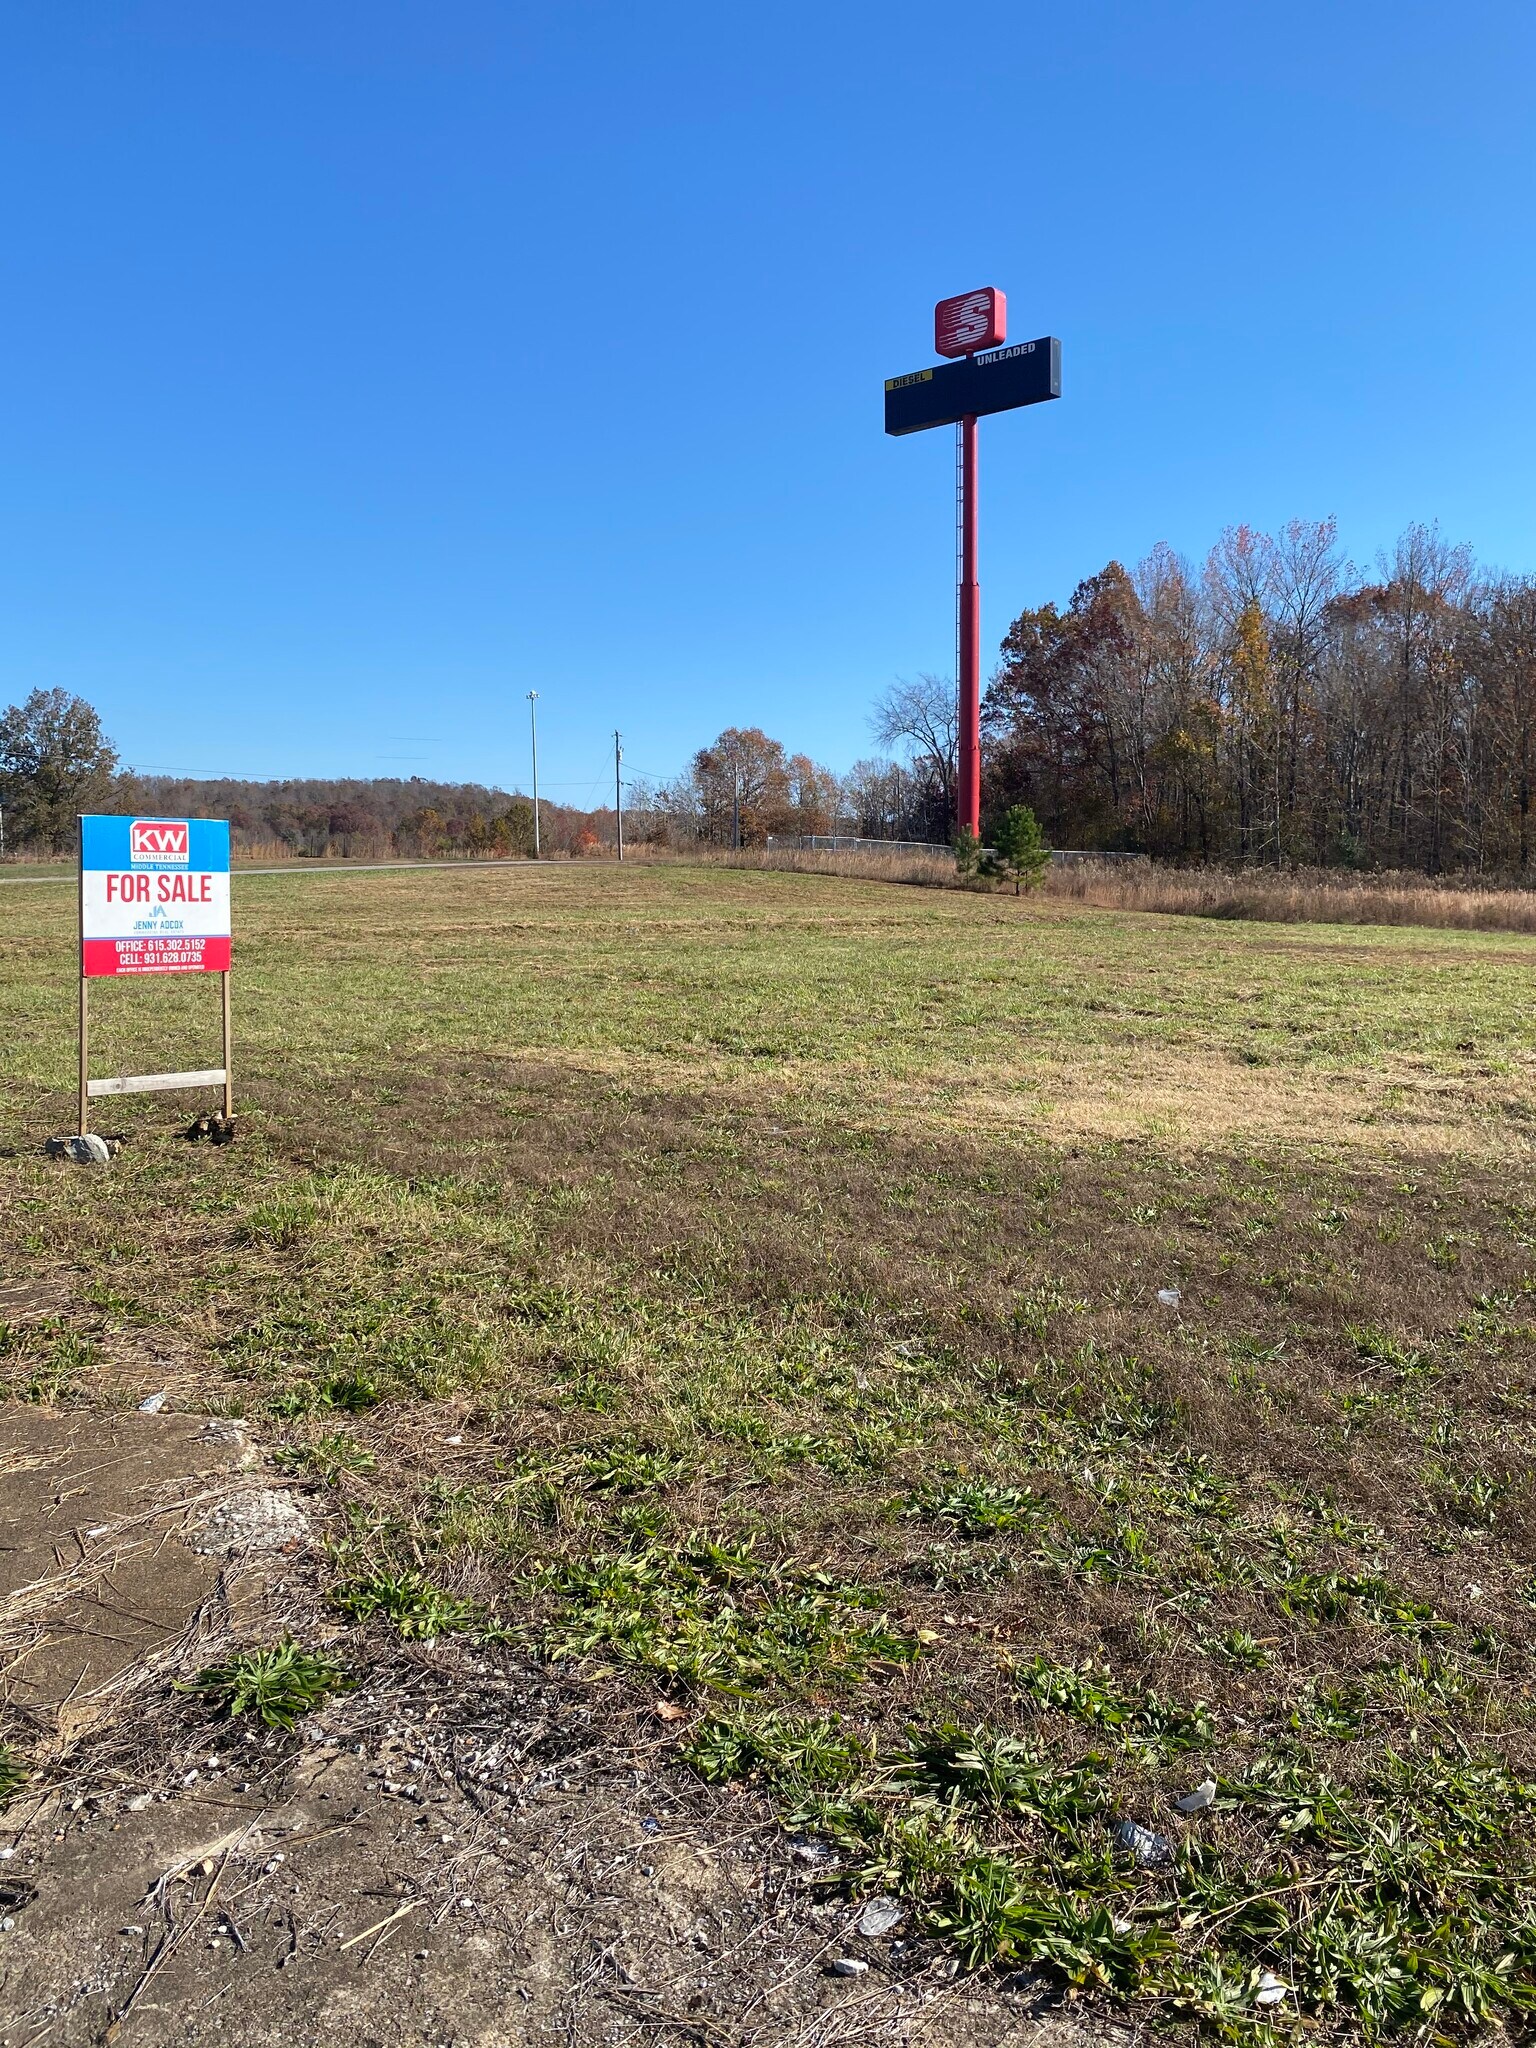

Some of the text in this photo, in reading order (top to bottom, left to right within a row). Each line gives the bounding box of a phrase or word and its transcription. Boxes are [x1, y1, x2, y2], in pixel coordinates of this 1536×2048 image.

[977, 342, 1036, 366] UNLEADED
[892, 372, 926, 389] DIESEL
[133, 829, 186, 852] KW
[107, 874, 212, 903] FOR SALE
[133, 920, 184, 930] JENNY ADCOX
[115, 939, 206, 953] OFFICE: 615.302.5152
[120, 951, 202, 965] CELL: 931.628.0735
